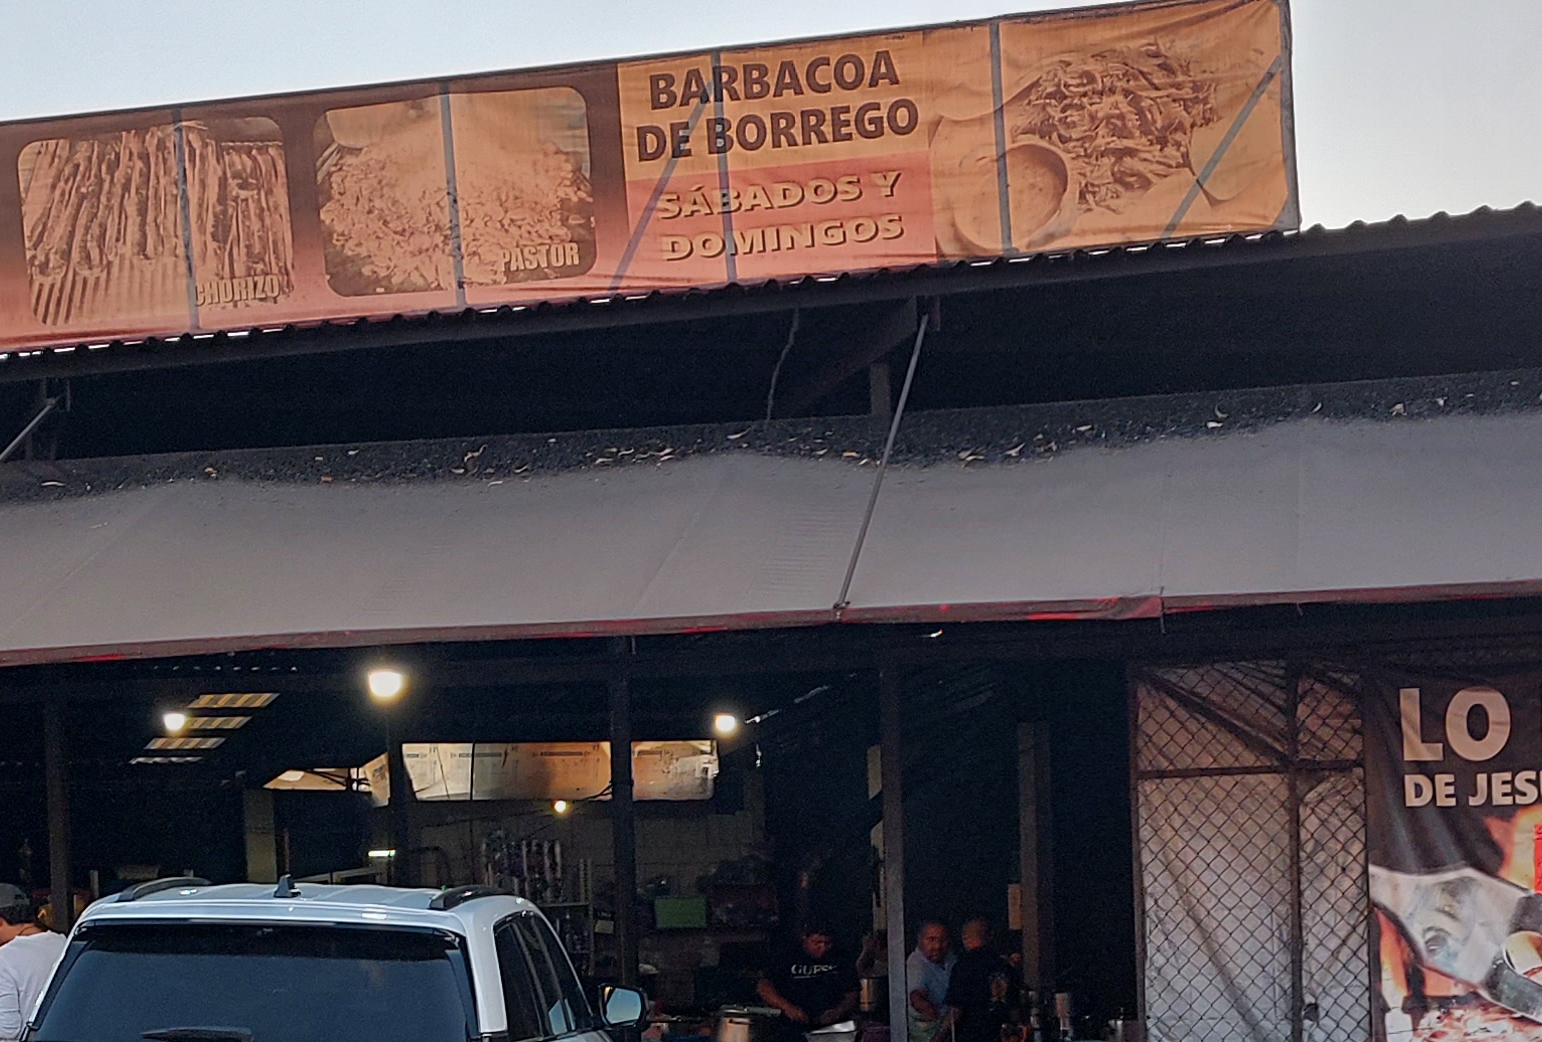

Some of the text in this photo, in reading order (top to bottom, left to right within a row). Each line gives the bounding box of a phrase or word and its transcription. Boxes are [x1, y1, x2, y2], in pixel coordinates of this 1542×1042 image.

[649, 50, 900, 111] BARBACOA
[636, 98, 919, 162] DE BORREGO
[658, 170, 902, 219] SÁBADOS Y
[500, 242, 580, 272] PASTOR
[661, 213, 905, 261] DOMINGOS
[195, 274, 281, 307] CHORIZO
[1399, 687, 1511, 762] LO
[1404, 773, 1457, 807] DE
